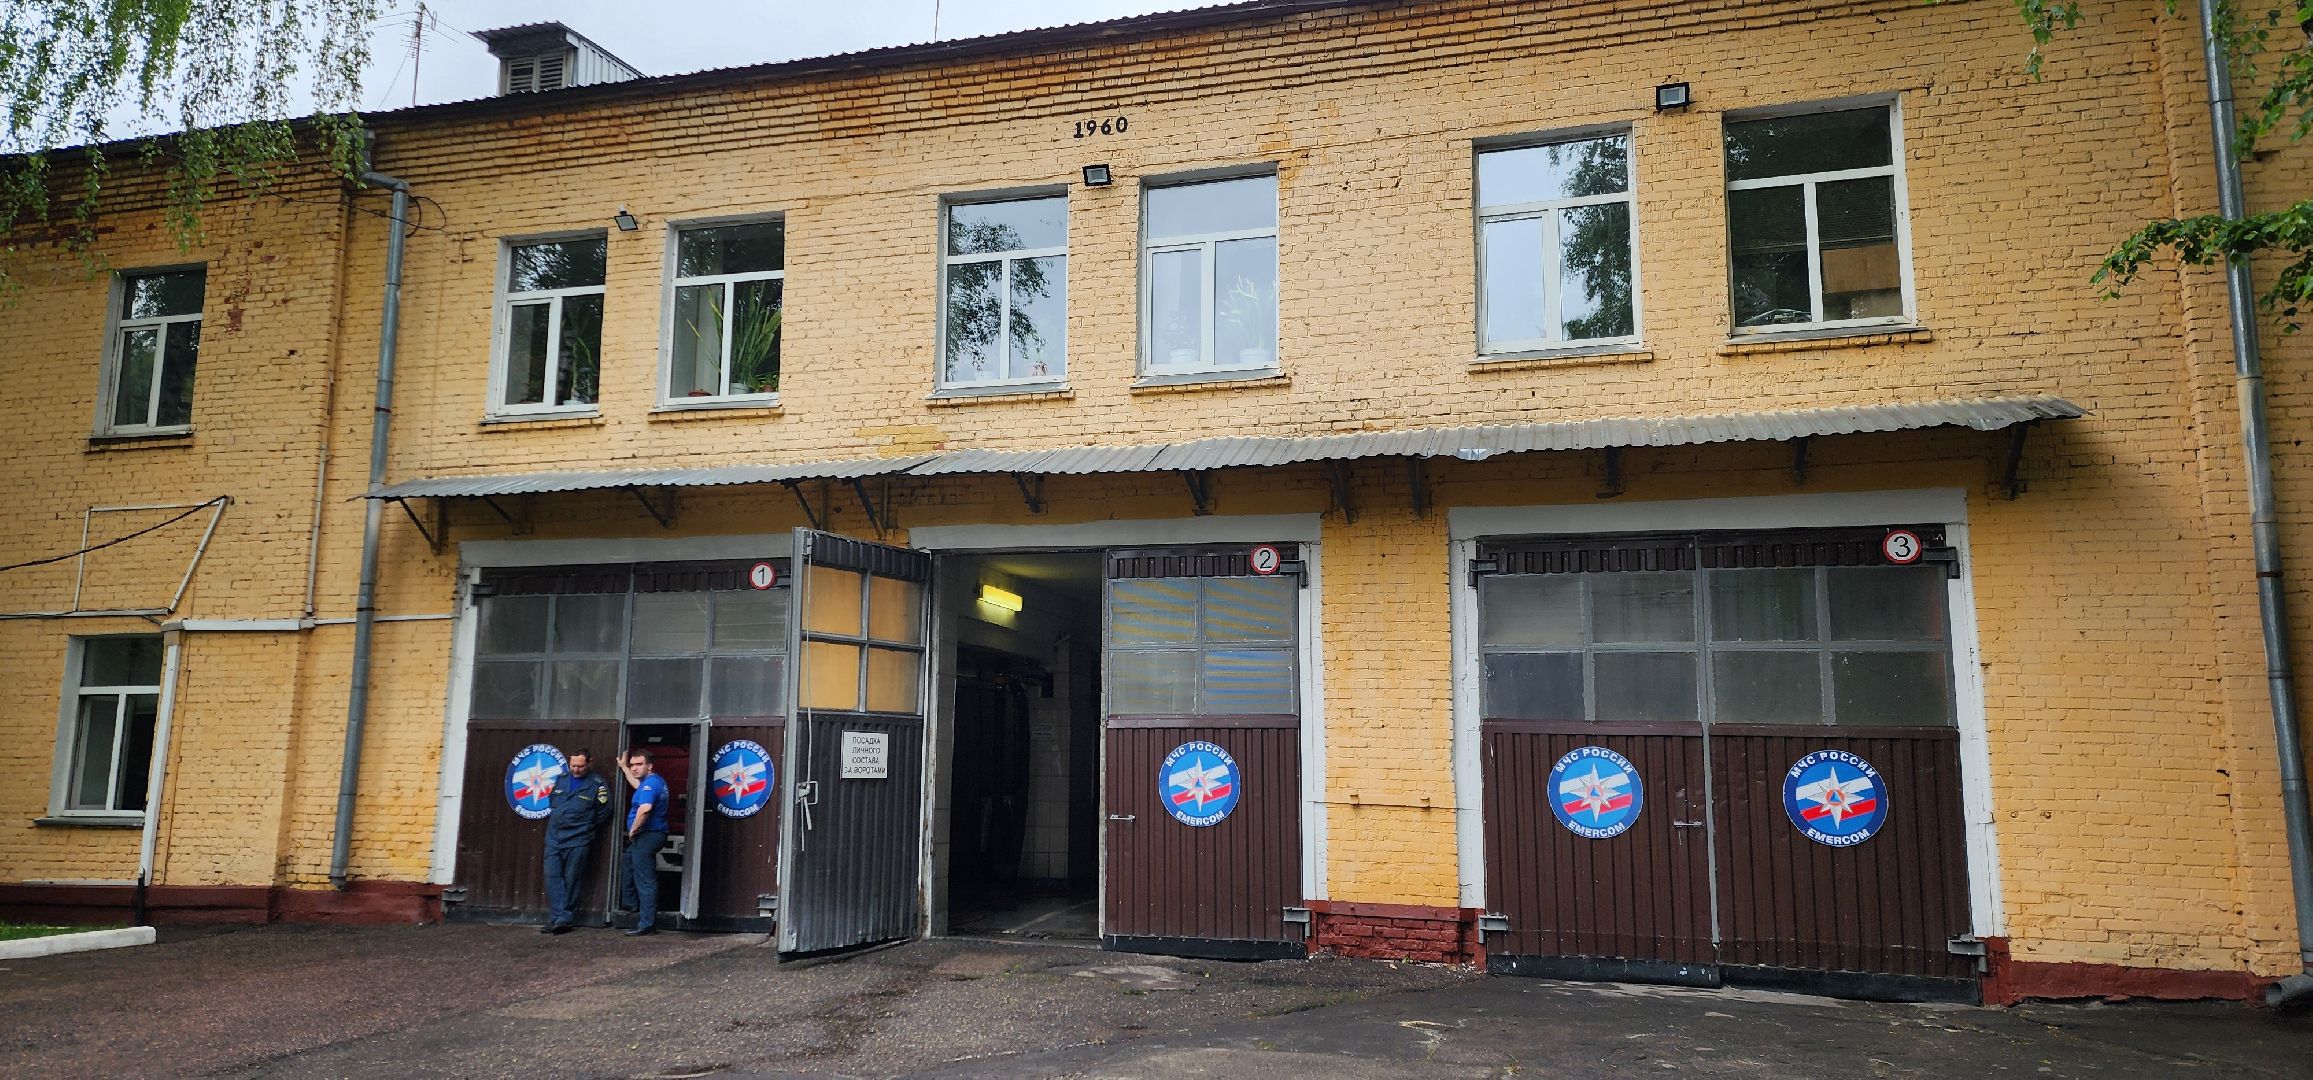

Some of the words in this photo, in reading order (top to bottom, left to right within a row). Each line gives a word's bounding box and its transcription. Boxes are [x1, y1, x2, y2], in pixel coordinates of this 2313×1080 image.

[1073, 116, 1128, 138] 1960
[1893, 536, 1911, 557] 3
[1259, 550, 1272, 568] 2
[758, 567, 766, 584] 1
[852, 736, 881, 745] ПОСАДКА
[512, 748, 531, 767] МЧС
[532, 745, 567, 767] РОССИИ
[713, 745, 731, 762] МЧС
[734, 741, 770, 763] РОССИИ
[852, 756, 880, 764] СОСТАВА
[1165, 747, 1186, 767] МЧС
[1189, 743, 1233, 765] РОССИИ
[1555, 752, 1579, 773] МЧС
[1582, 748, 1634, 774] РОССИИ
[853, 766, 886, 774] ВОРОТАМИ
[1790, 756, 1816, 778] МЧС
[1819, 752, 1876, 778] РОССИИ
[717, 803, 760, 817] EMERCOM
[1176, 810, 1225, 825] EMERCOM
[1568, 820, 1626, 838] EMERCOM
[1806, 828, 1870, 844] EMERCOM
